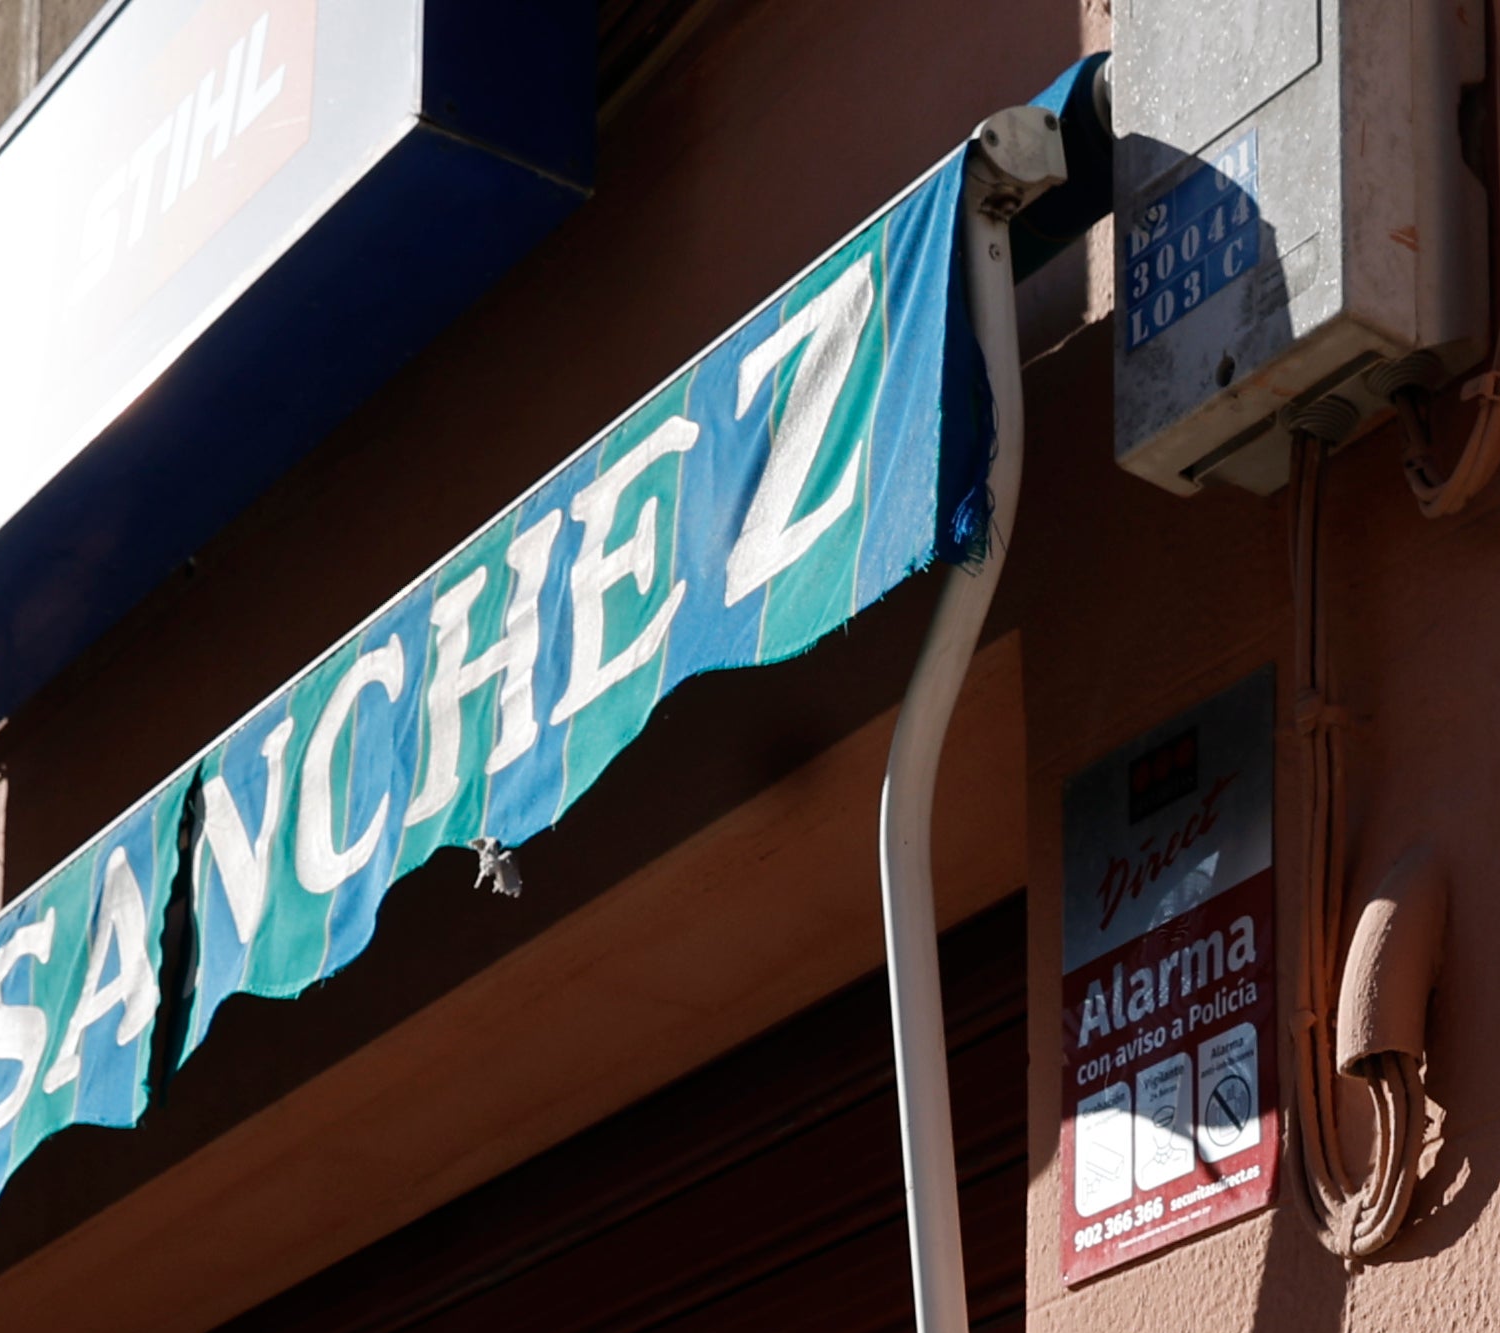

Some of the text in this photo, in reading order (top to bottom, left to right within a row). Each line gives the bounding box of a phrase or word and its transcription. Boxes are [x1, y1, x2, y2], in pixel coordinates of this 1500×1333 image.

[75, 10, 286, 300] STIHL
[1096, 772, 1238, 932] Direct
[1077, 913, 1258, 1049] Alarma
[1077, 977, 1258, 1086] con aviso a Policía
[1074, 1220, 1102, 1252] 902
[1104, 1209, 1133, 1240] 366
[1134, 1195, 1164, 1227] 366
